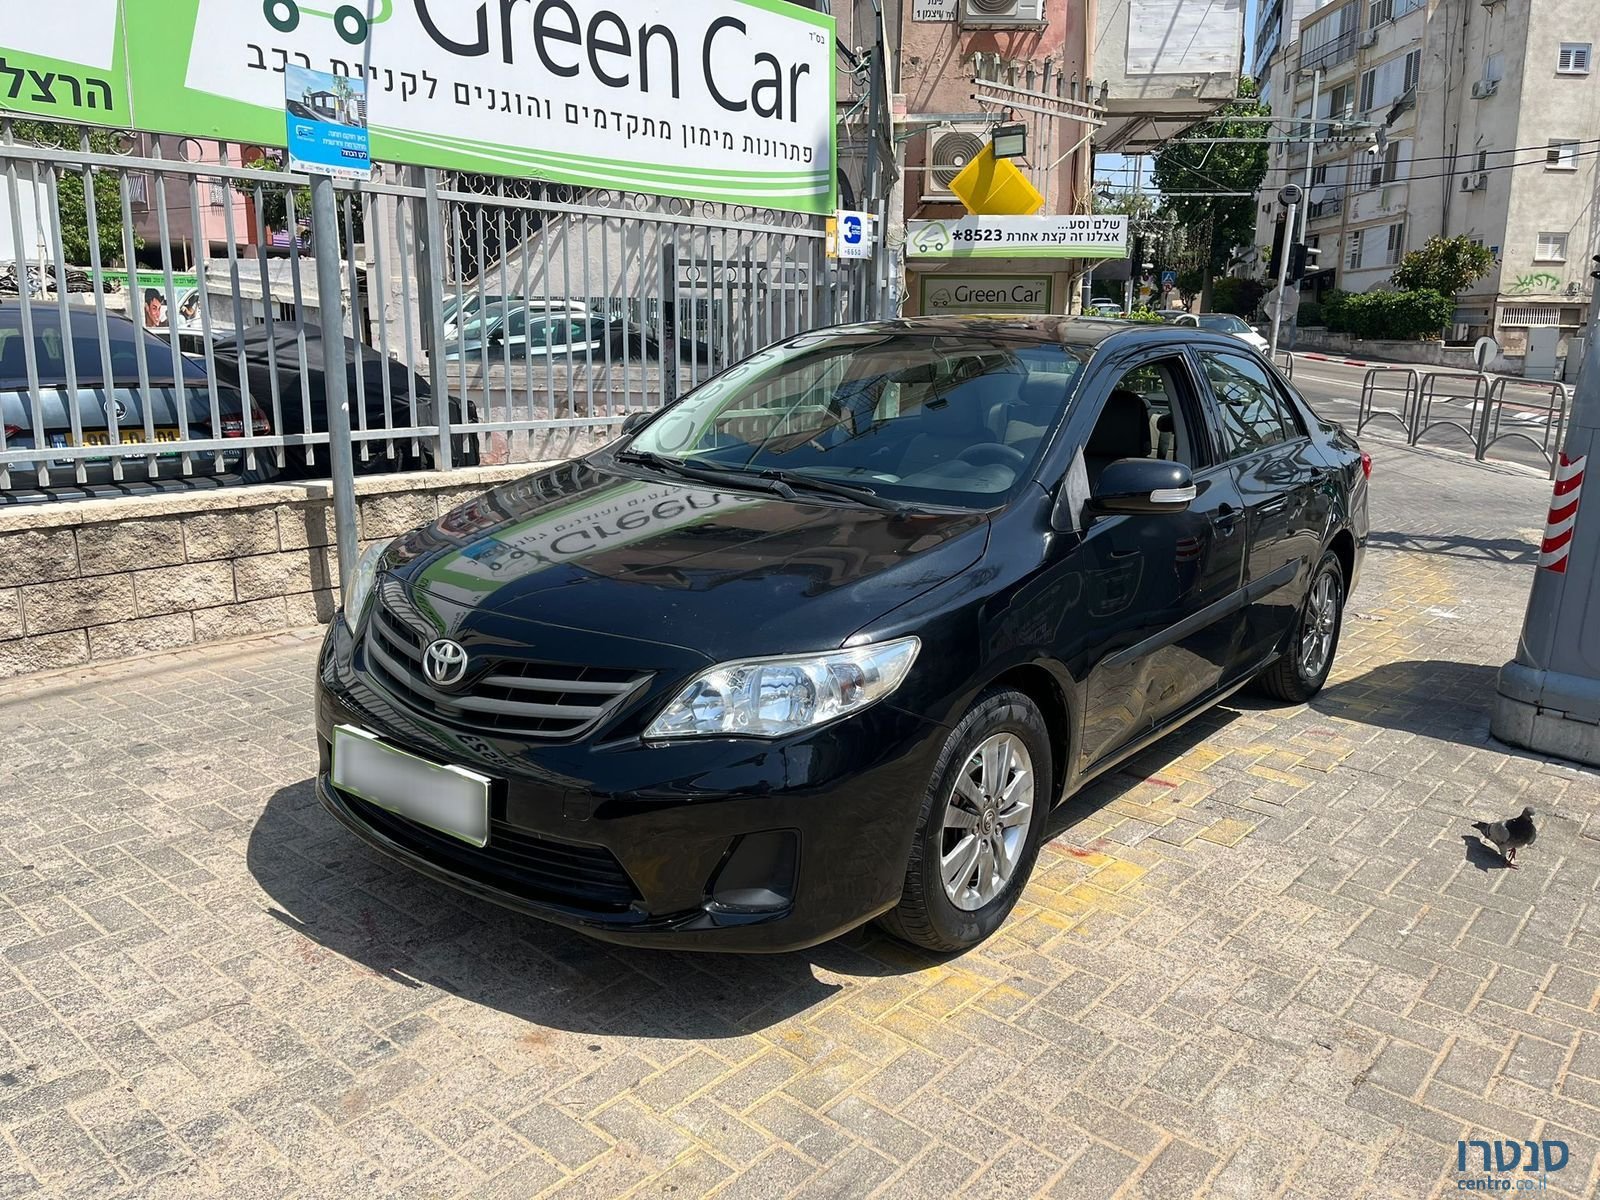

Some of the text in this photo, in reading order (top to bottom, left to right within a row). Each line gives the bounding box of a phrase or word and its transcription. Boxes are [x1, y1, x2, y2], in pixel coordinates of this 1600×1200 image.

[413, 0, 810, 123] Green Car
[453, 82, 552, 120] והוגנים
[565, 103, 672, 140] מתקדמים
[681, 124, 734, 150] מימון
[742, 135, 813, 163] פתרונות
[1093, 219, 1120, 230] שלם
[1006, 231, 1038, 242] אחרת
[1041, 231, 1066, 244] קצת
[1070, 231, 1083, 242] זה
[1086, 230, 1120, 242] אצלנו
[954, 285, 1042, 303] Green Car
